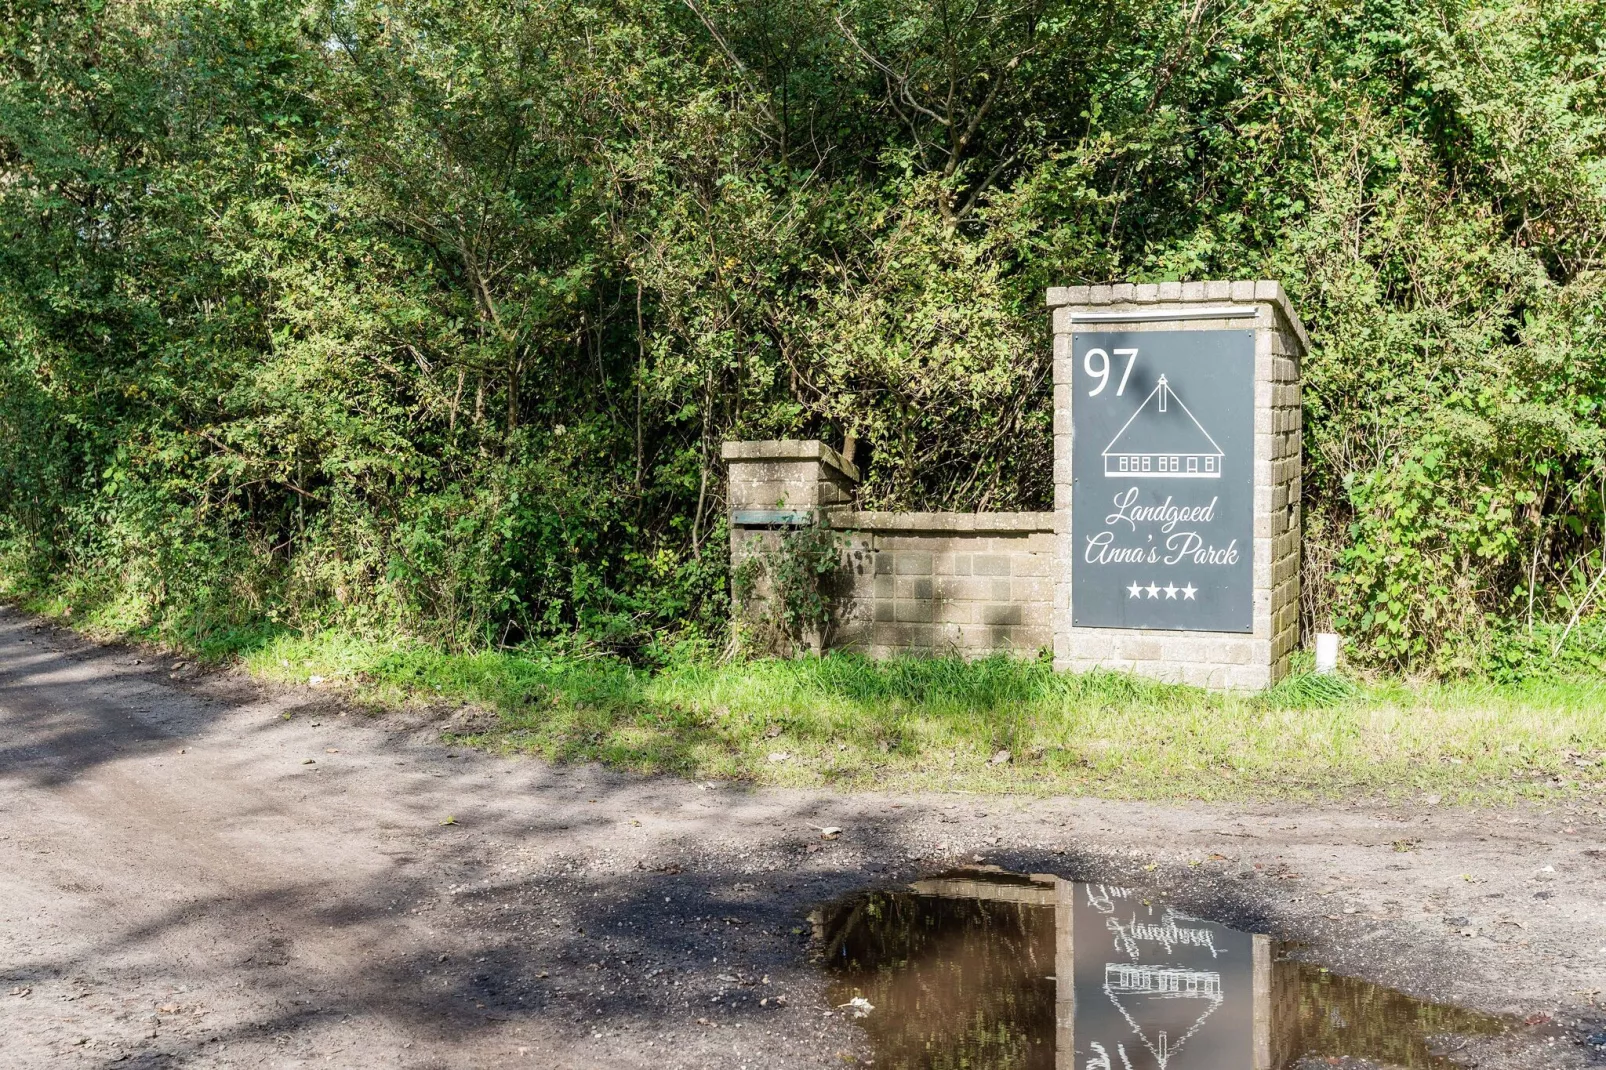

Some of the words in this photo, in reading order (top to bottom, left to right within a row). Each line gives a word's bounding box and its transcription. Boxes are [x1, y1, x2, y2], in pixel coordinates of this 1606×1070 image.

[1083, 348, 1139, 397] 97
[1105, 487, 1218, 533] Landgoed
[1084, 531, 1160, 565] Anna's
[1163, 531, 1239, 565] Parck
